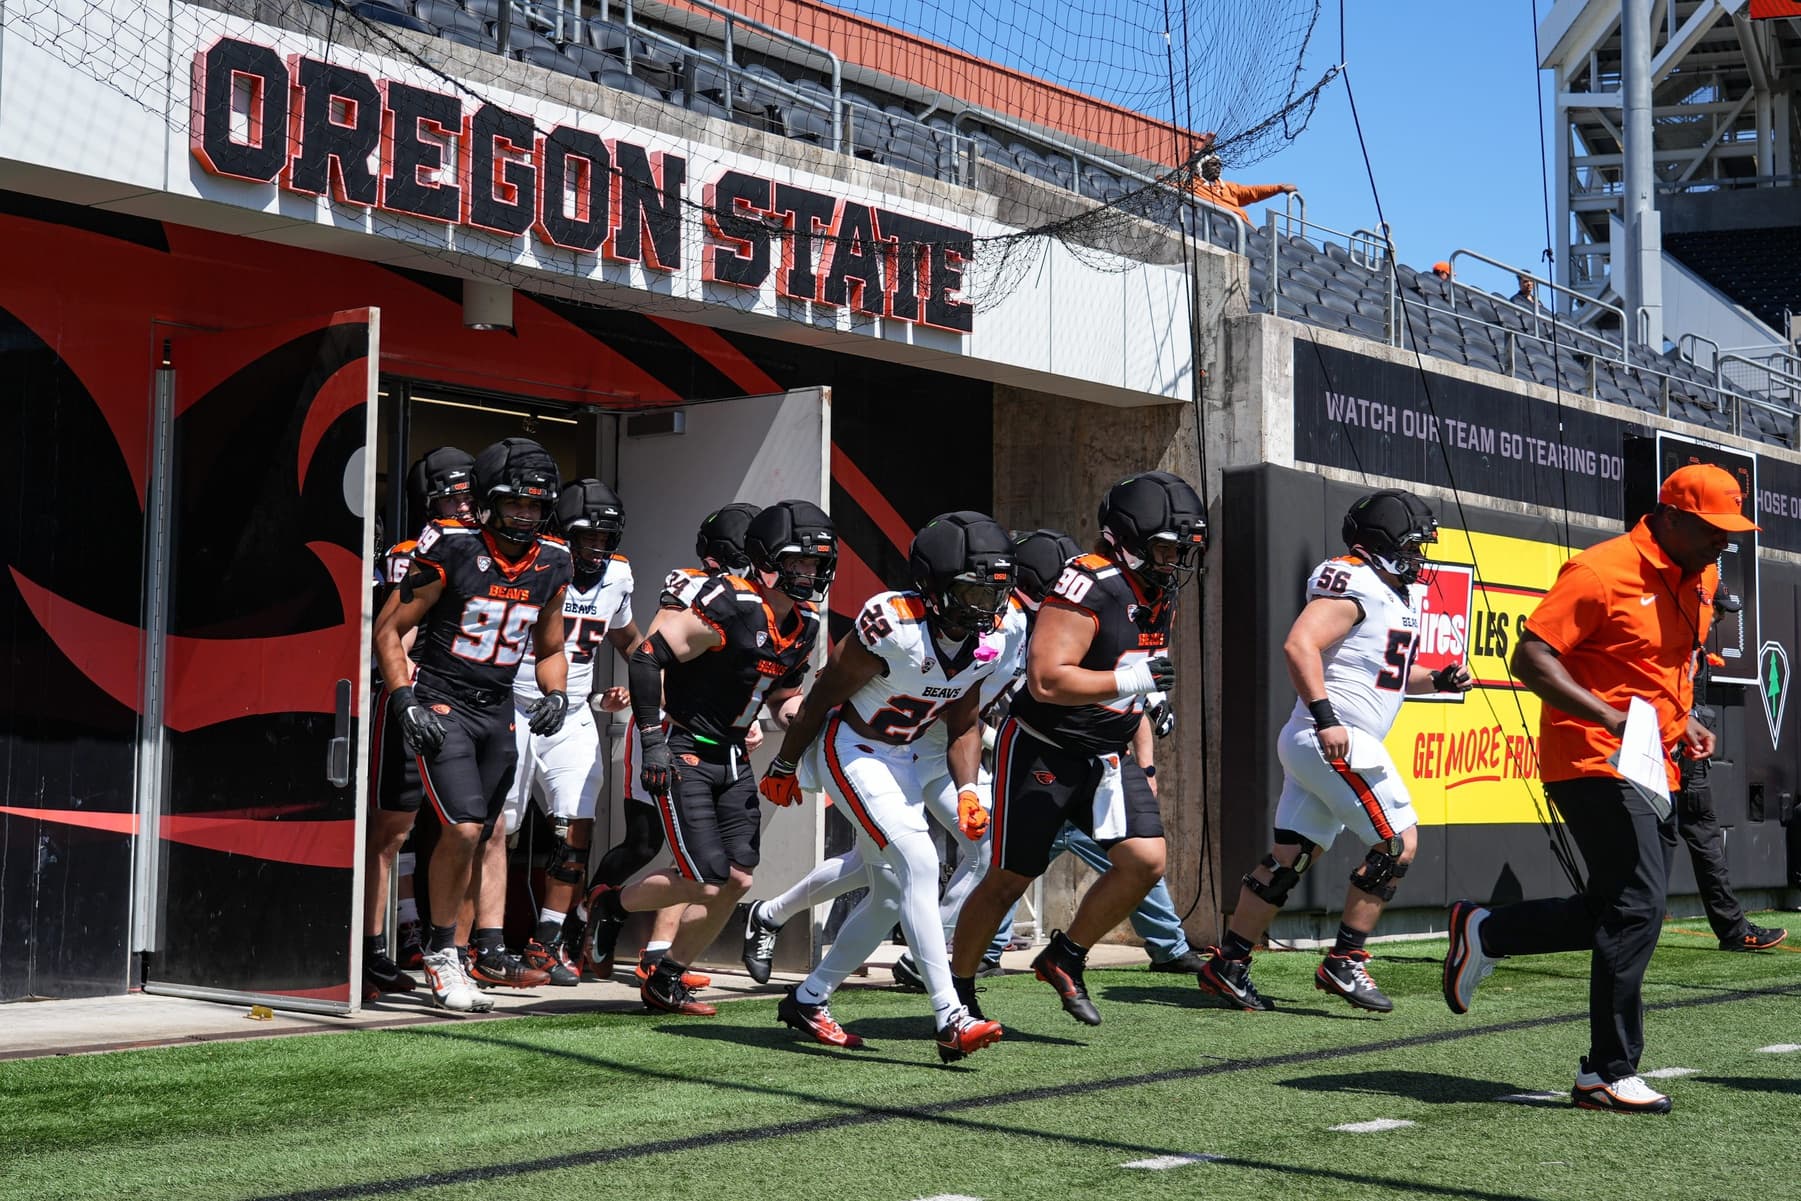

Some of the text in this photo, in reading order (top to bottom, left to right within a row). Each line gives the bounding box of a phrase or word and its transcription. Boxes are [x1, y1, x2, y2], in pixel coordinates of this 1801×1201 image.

[190, 37, 974, 334] OREGON STATE
[1326, 391, 1624, 481] WATCH OUR TEAM GO TEARING DO
[488, 585, 530, 600] BEAVS
[1054, 567, 1093, 604] 90
[1317, 566, 1351, 594] 56
[564, 602, 597, 616] BEAVS
[860, 603, 893, 646] 22
[451, 596, 542, 666] 99
[1474, 610, 1509, 658] LES
[922, 686, 961, 698] BEAVS
[1413, 732, 1445, 779] GET
[1445, 724, 1502, 777] MORE
